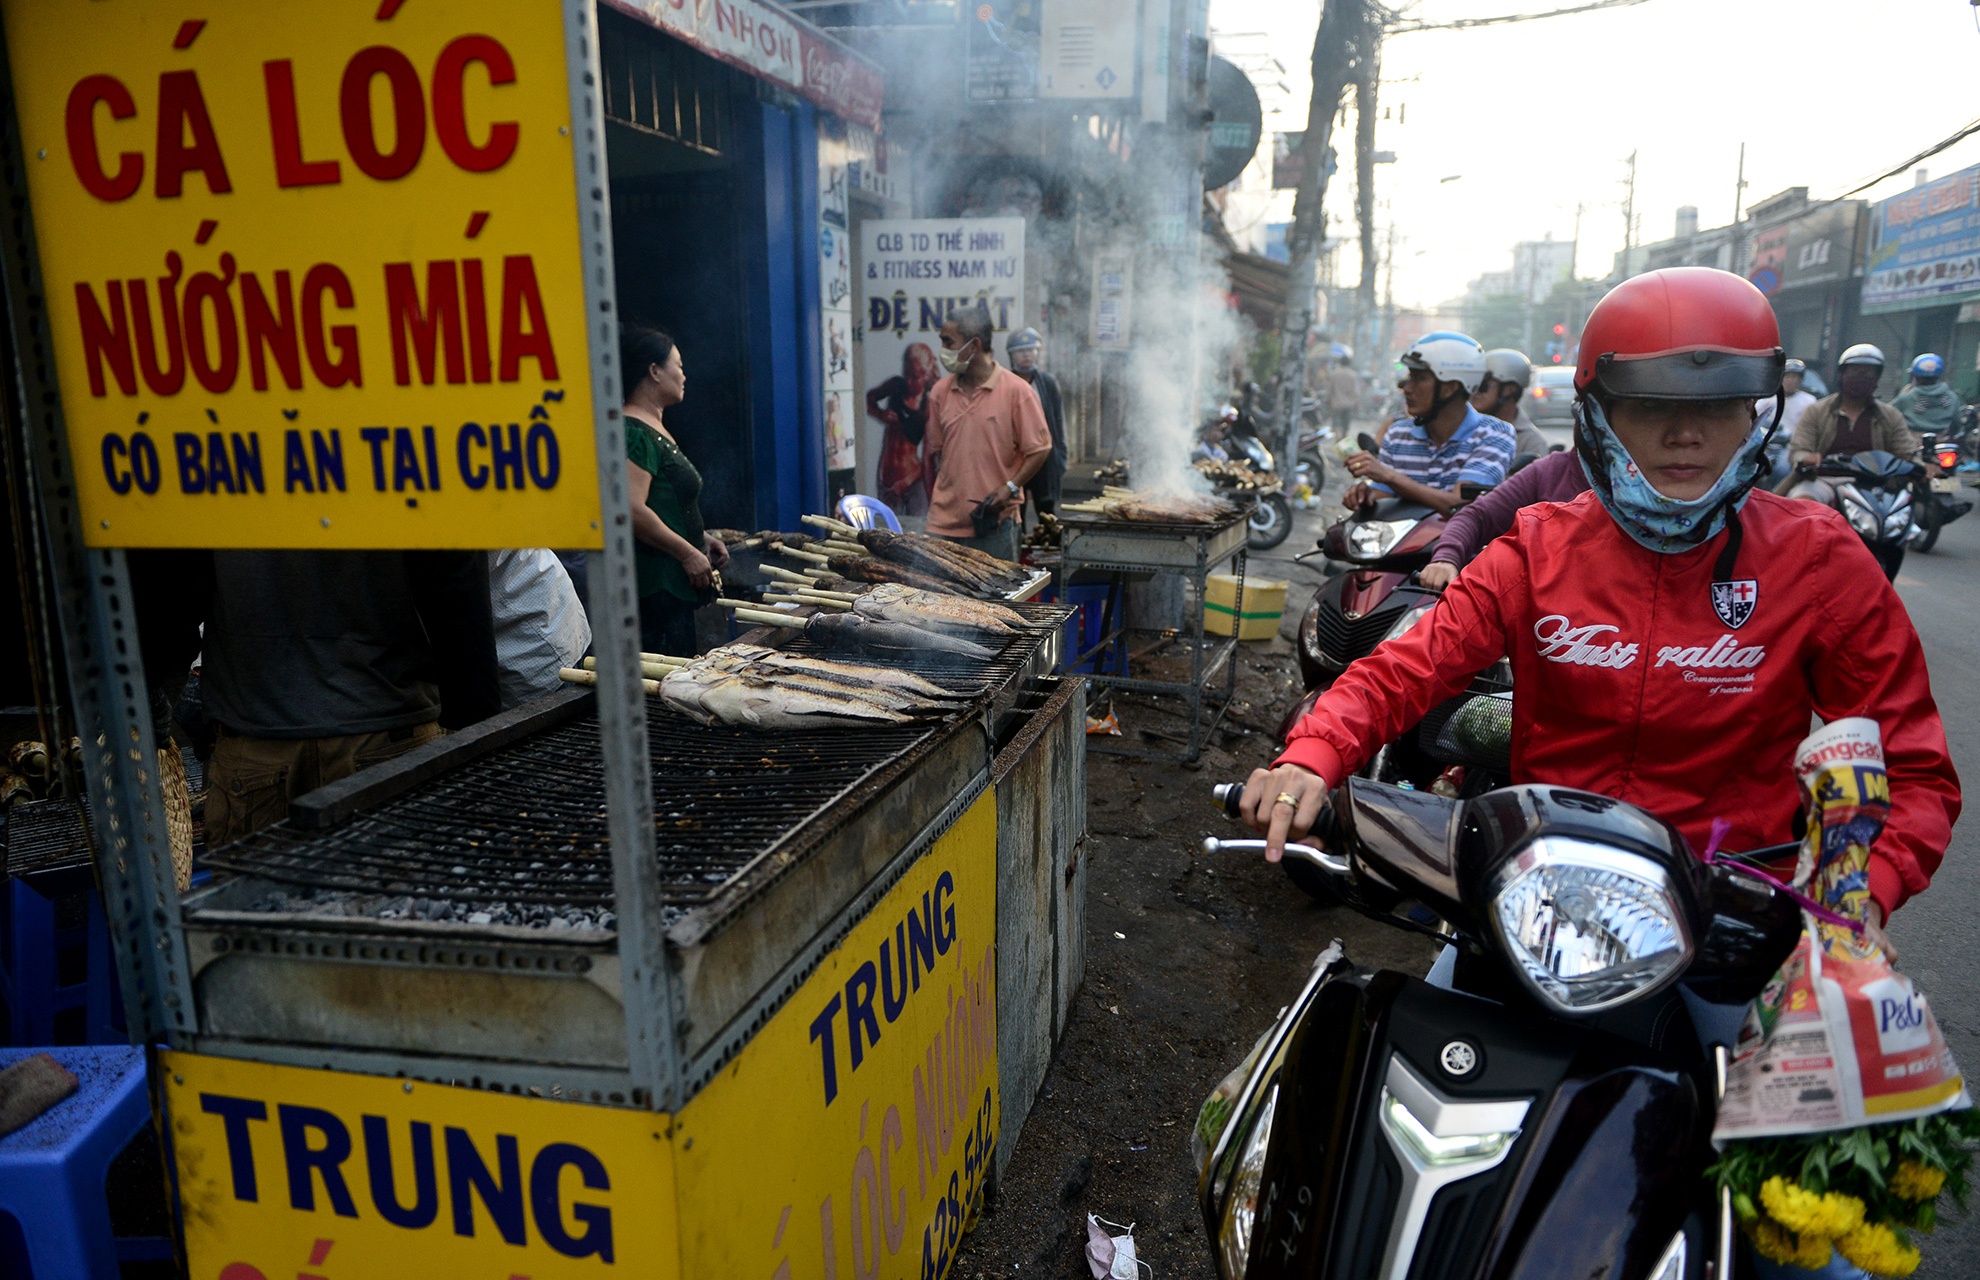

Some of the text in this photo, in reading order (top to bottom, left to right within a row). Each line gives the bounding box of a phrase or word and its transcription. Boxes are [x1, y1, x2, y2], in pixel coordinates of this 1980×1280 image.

[65, 0, 519, 202] CÁ LÓC
[74, 211, 560, 397] NƯỚNG MÍA
[867, 263, 878, 279] &
[884, 260, 942, 279] FITNESS
[948, 259, 987, 278] NAM
[868, 289, 911, 340] ĐỆ
[876, 233, 903, 251] CLB
[102, 389, 564, 509] CÓ BÀN ĂN TẠI CHỖ
[810, 870, 956, 1108] TRUNG
[199, 1093, 615, 1264] TRUNG
